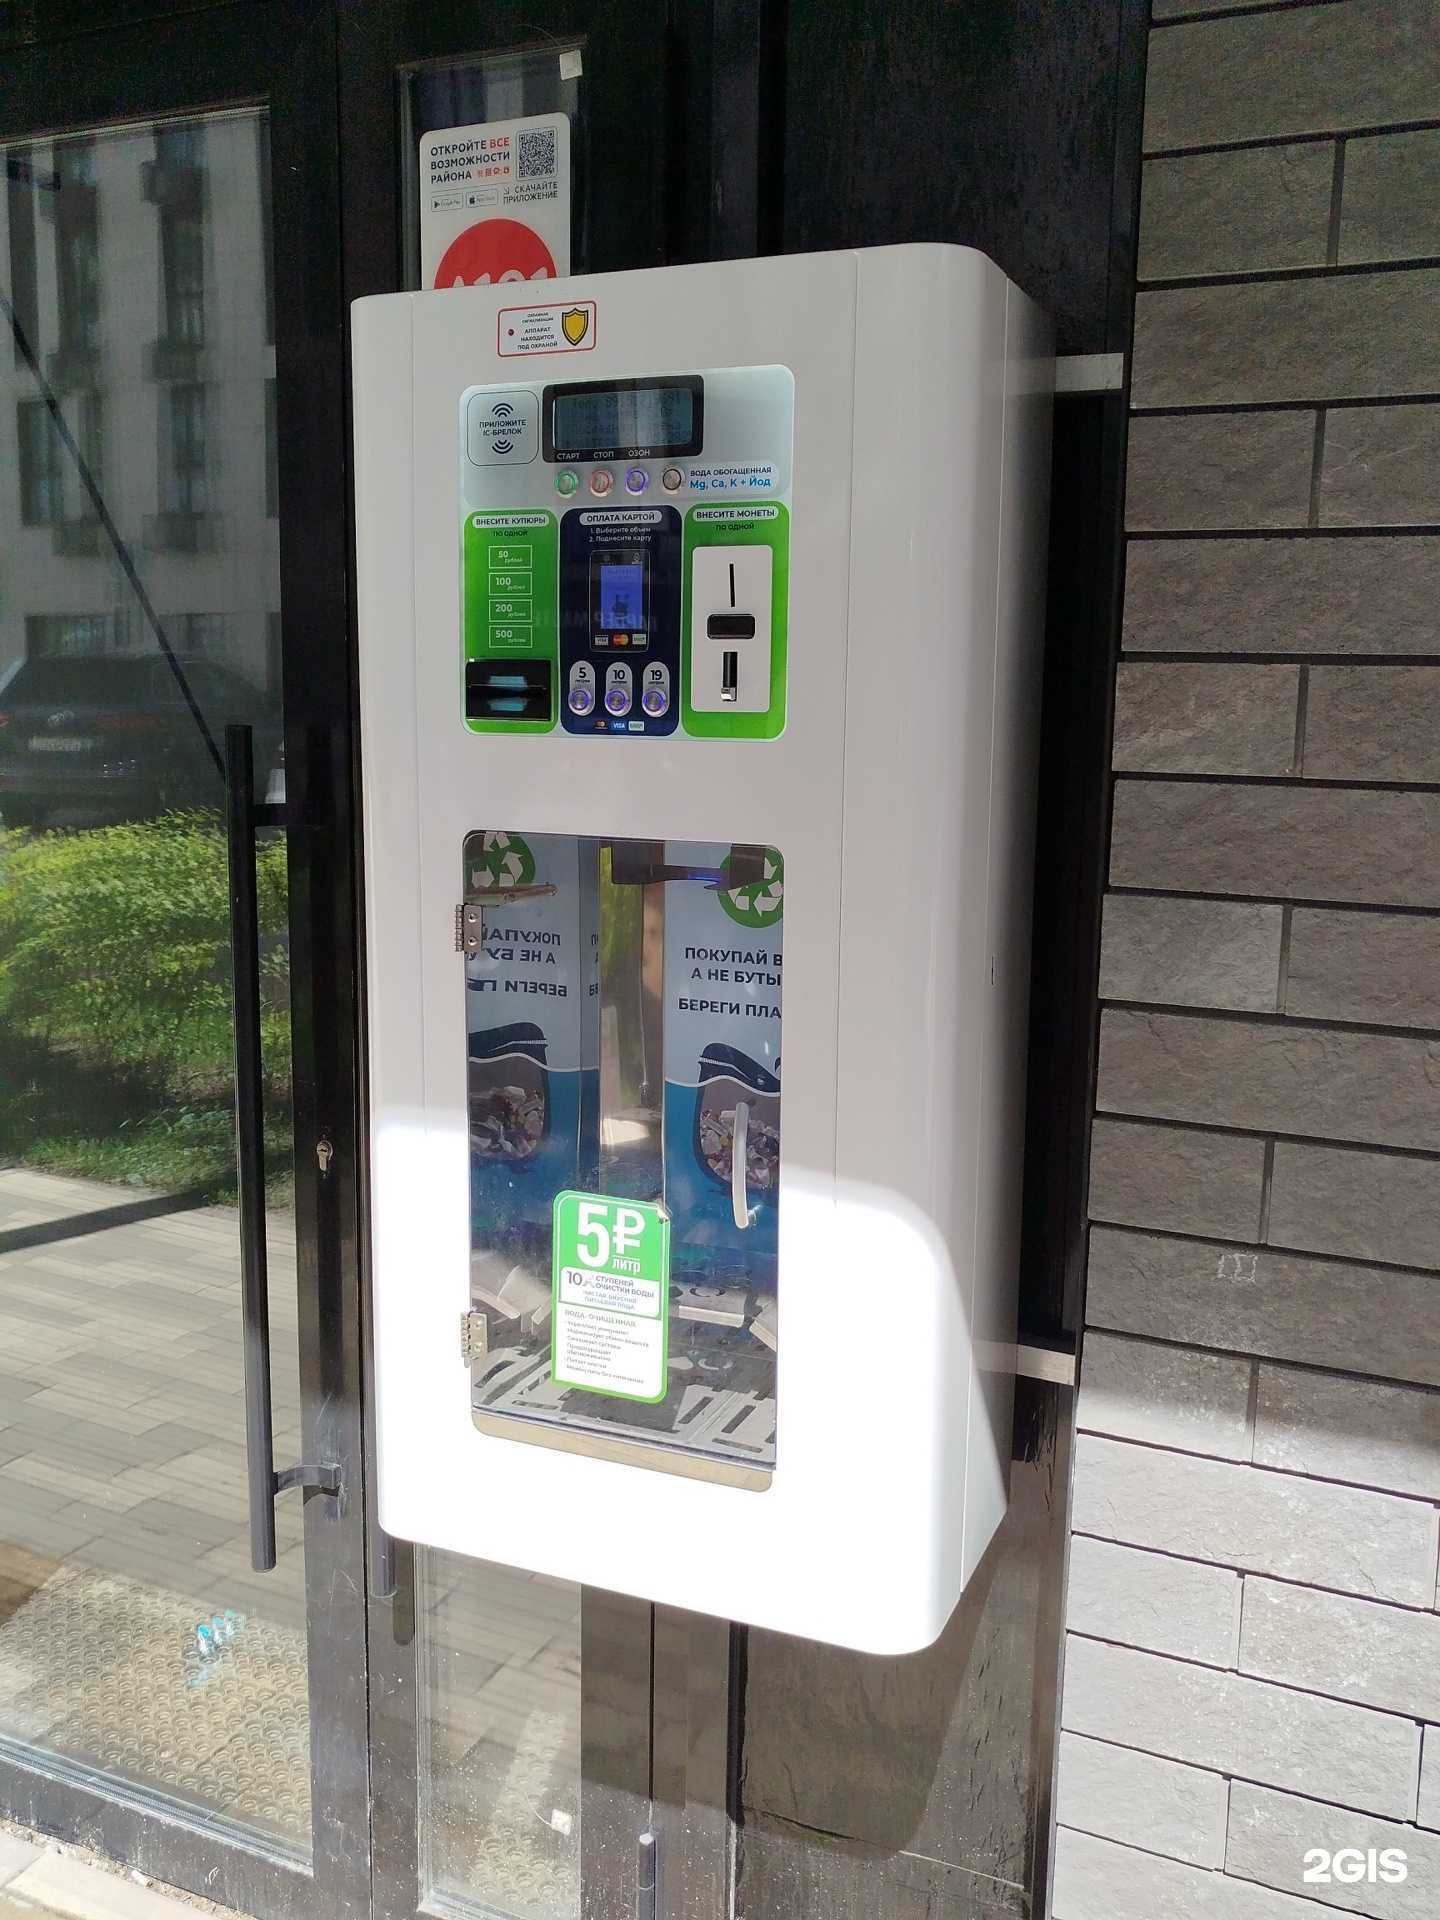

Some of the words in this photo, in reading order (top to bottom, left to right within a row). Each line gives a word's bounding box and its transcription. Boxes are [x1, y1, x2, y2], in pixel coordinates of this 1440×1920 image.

[431, 139, 487, 156] ОТКРОЙТЕ
[490, 137, 510, 149] ВСЕ
[431, 151, 510, 170] ВОЗМОЖНОСТИ
[431, 170, 472, 184] РАЙОНА
[514, 181, 558, 194] СКАЧАЙТЕ
[503, 190, 558, 205] ПРИЛОЖЕНИЕ
[524, 326, 551, 334] АППАРАТ
[531, 341, 558, 349] ОХРАНОЙ
[480, 419, 527, 428] ПРИЛОЖИТЕ
[556, 452, 580, 460] СТАРТ
[593, 450, 614, 459] СТОП
[628, 449, 650, 457] ОЗОН
[690, 469, 711, 477] ВОДА
[713, 467, 772, 476] ОБОГАЩЕННАЯ
[587, 514, 620, 522] ОПЛАТА
[622, 512, 655, 520] КАРТОЙ
[696, 511, 735, 519] ВНЕСИТЕ
[737, 509, 775, 518] МОНЕТЫ
[476, 517, 510, 526] ВНЕСИТЕ
[511, 517, 546, 525] КУПЮРЫ
[729, 522, 755, 531] одной
[498, 550, 508, 558] 50
[496, 577, 511, 586] 100
[495, 604, 512, 612] 200
[495, 630, 512, 638] 500
[579, 667, 586, 678] 5
[613, 669, 625, 680] 10
[650, 669, 662, 680] 19
[685, 947, 768, 965] ПОКУПАЙ
[691, 967, 702, 979] А
[708, 968, 729, 982] НЕ
[734, 970, 781, 986] БУТЫ
[678, 998, 740, 1015] БЕРЕГИ
[745, 1003, 782, 1019] ПЛА
[566, 1270, 583, 1286] 10
[595, 1275, 634, 1287] СТУПЕНЕЙ
[595, 1283, 630, 1294] ОЧИСТКИ
[631, 1288, 655, 1298] ВОДЫ
